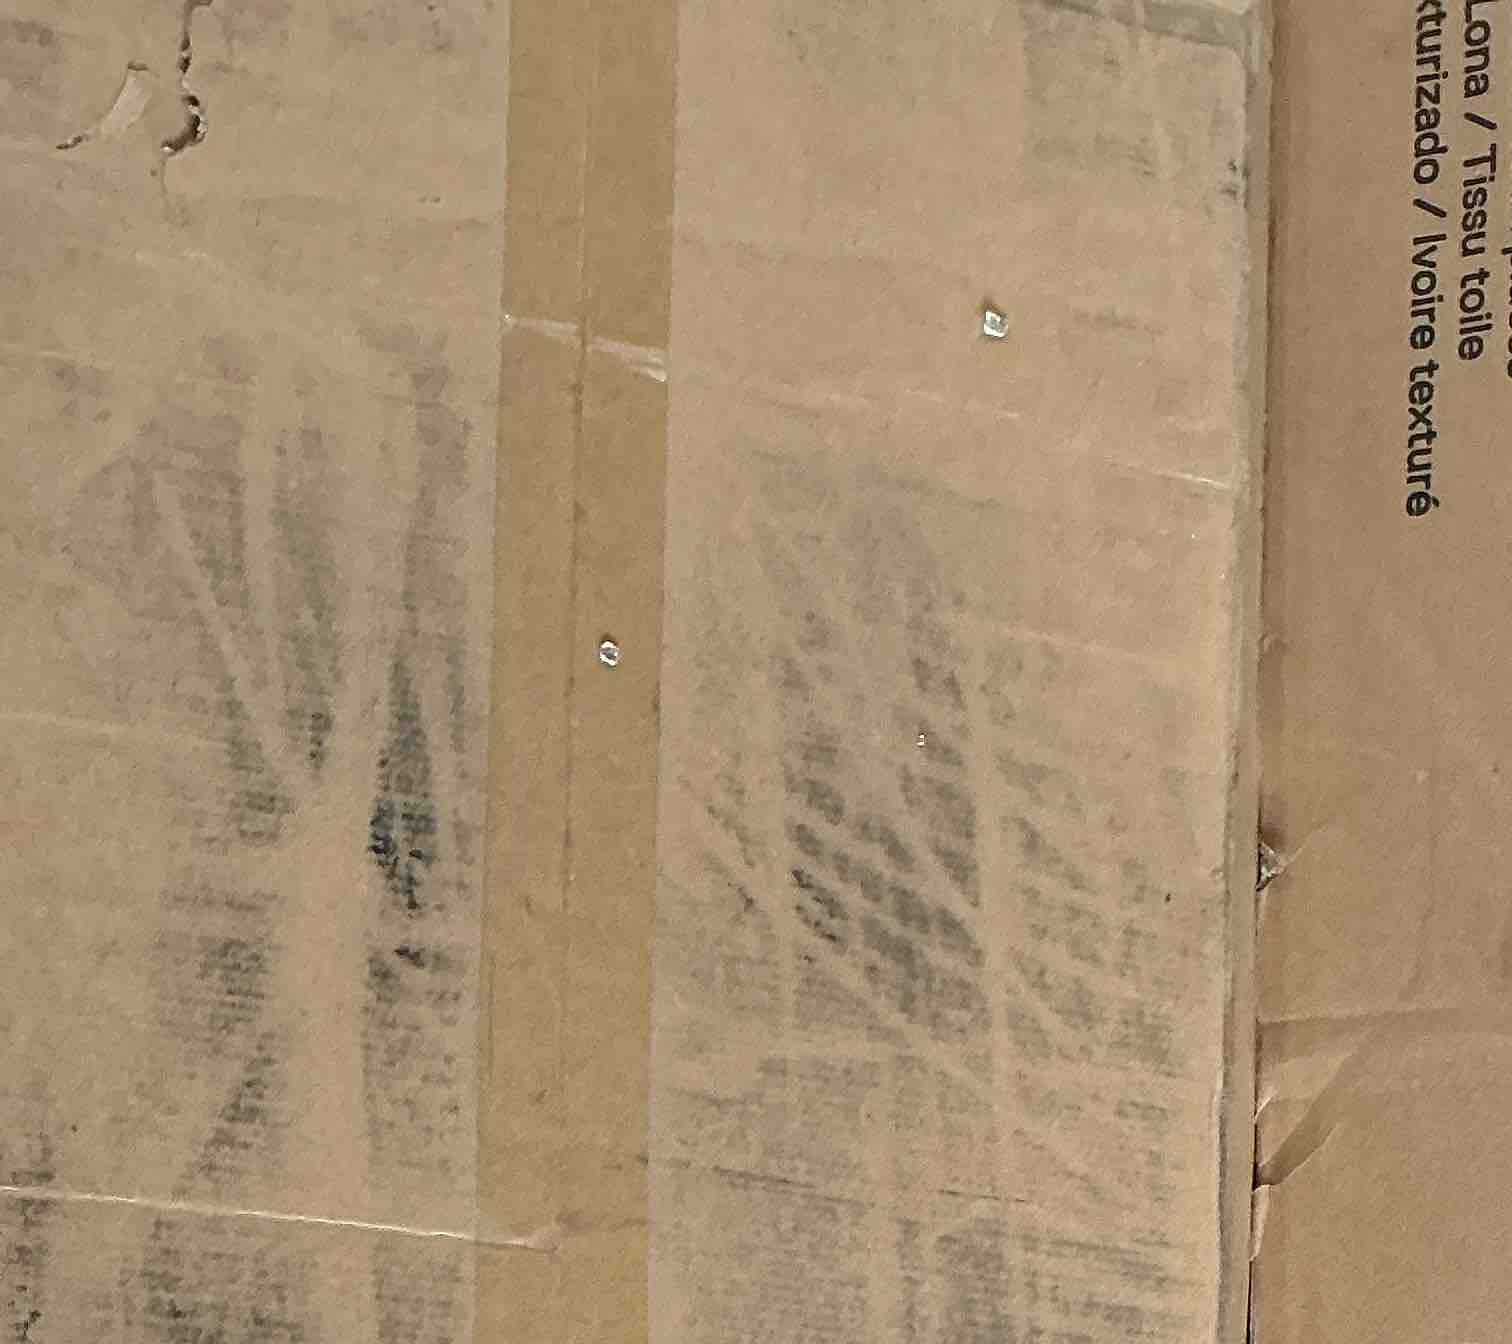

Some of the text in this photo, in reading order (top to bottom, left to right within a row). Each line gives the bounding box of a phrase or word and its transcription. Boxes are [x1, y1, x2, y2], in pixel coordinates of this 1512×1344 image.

[1464, 112, 1497, 130] /
[1413, 198, 1447, 218] /
[1461, 143, 1496, 257] Tissu
[1409, 233, 1447, 350] Ivoire
[1458, 268, 1493, 360] toile
[1406, 359, 1440, 517] texturé
